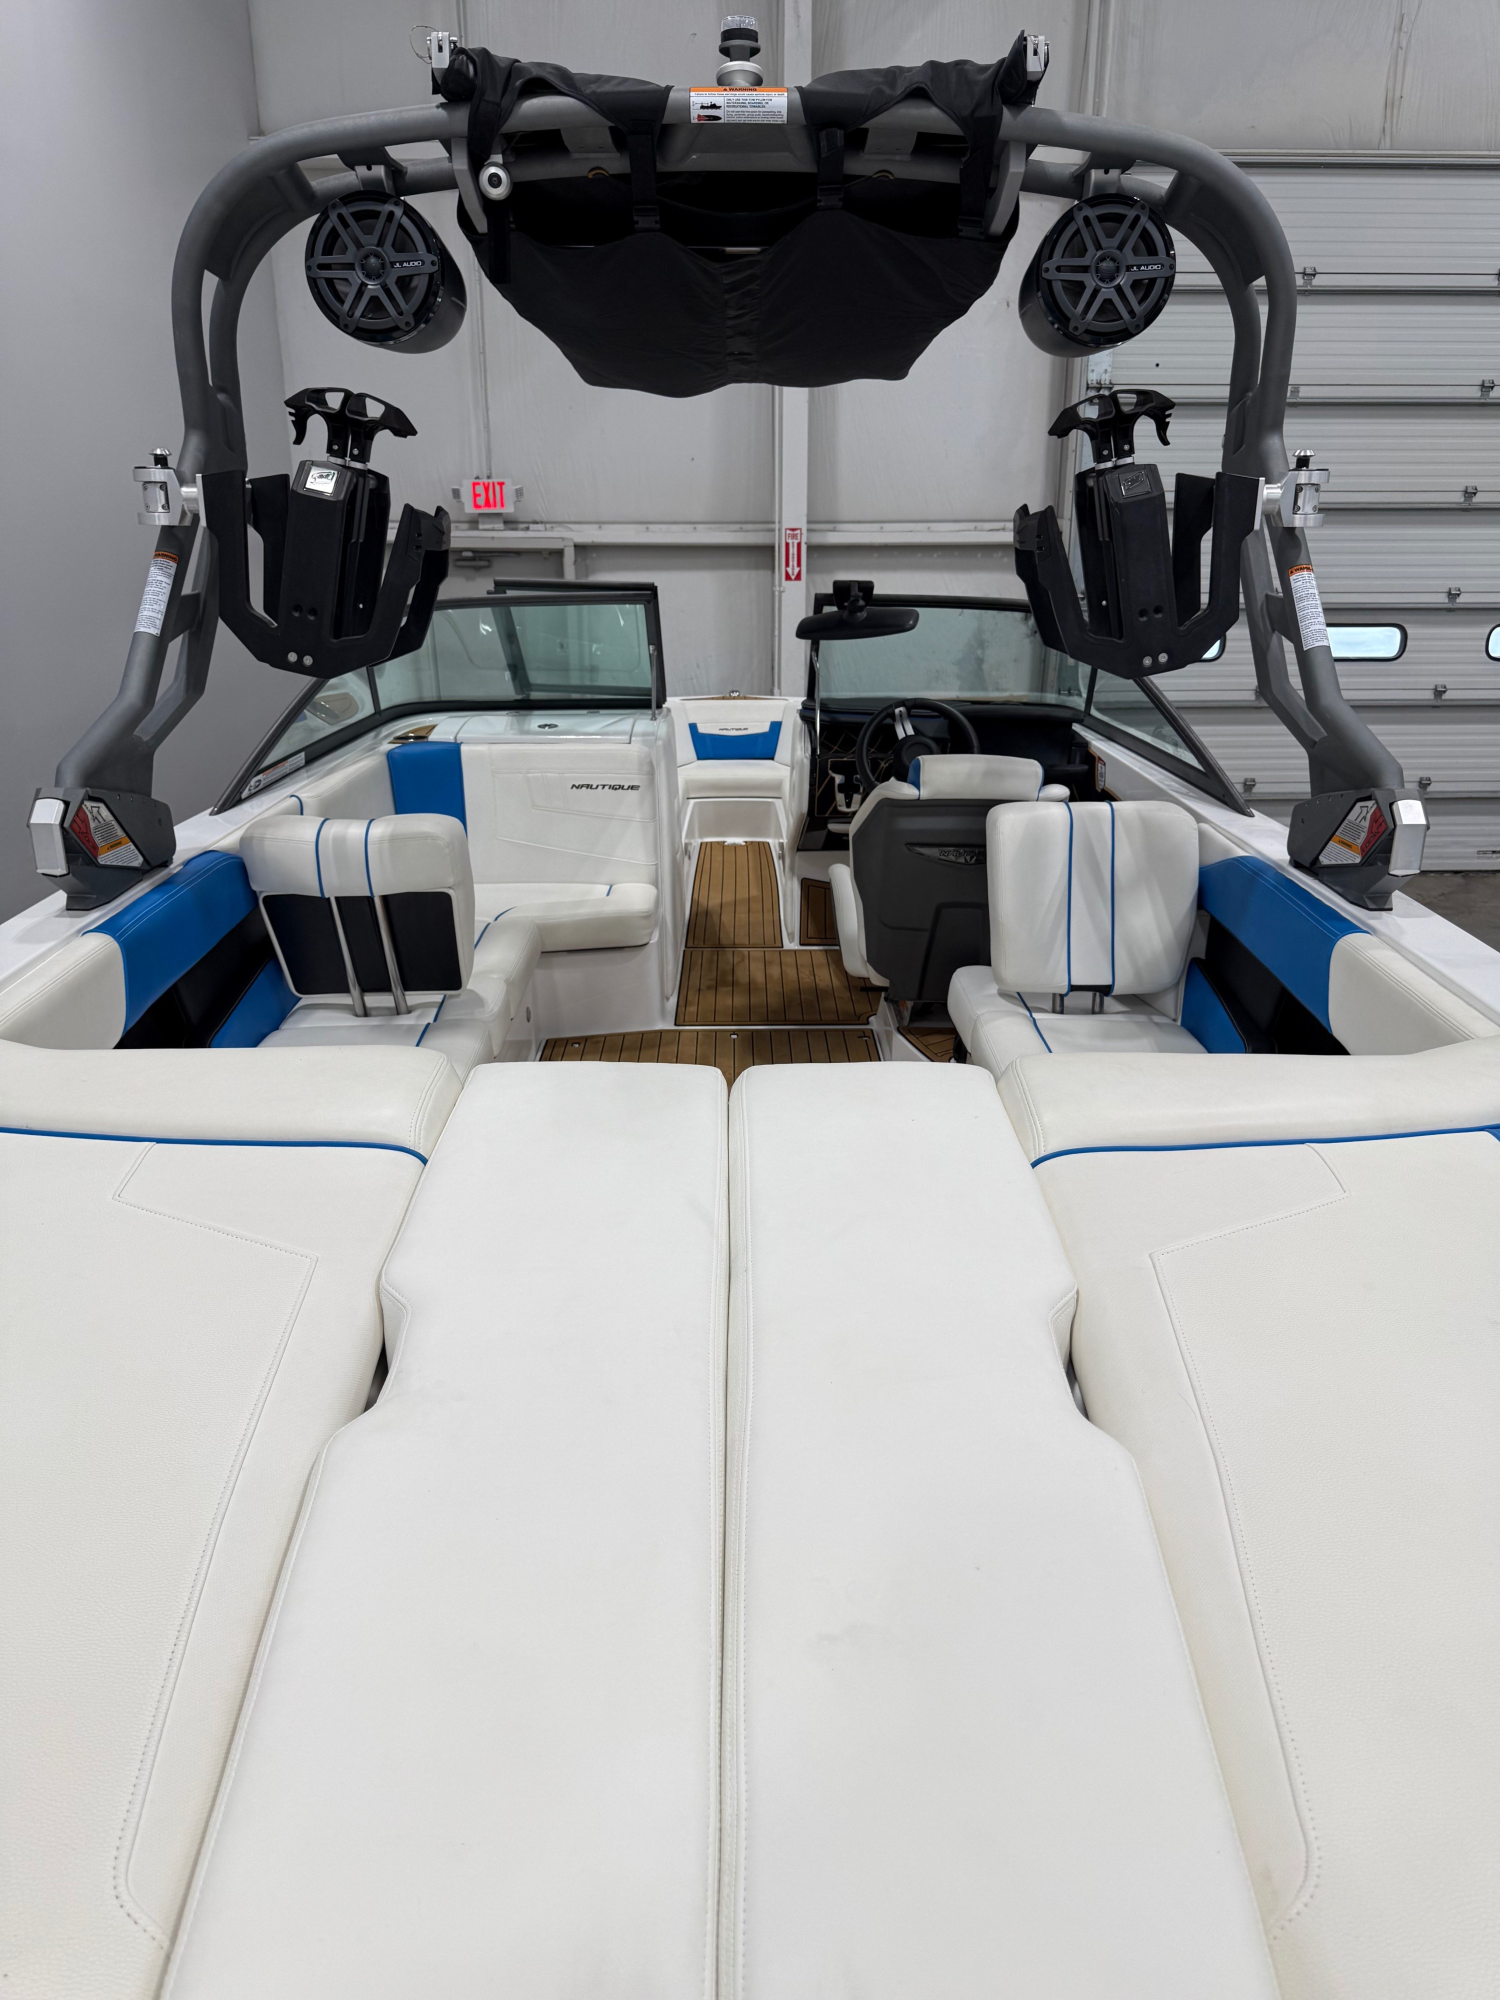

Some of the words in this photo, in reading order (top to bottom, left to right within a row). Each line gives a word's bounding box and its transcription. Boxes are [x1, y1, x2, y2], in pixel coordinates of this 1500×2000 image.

[471, 481, 506, 510] EXIT
[788, 533, 799, 541] FIRE
[570, 783, 641, 791] NAUTIQUE
